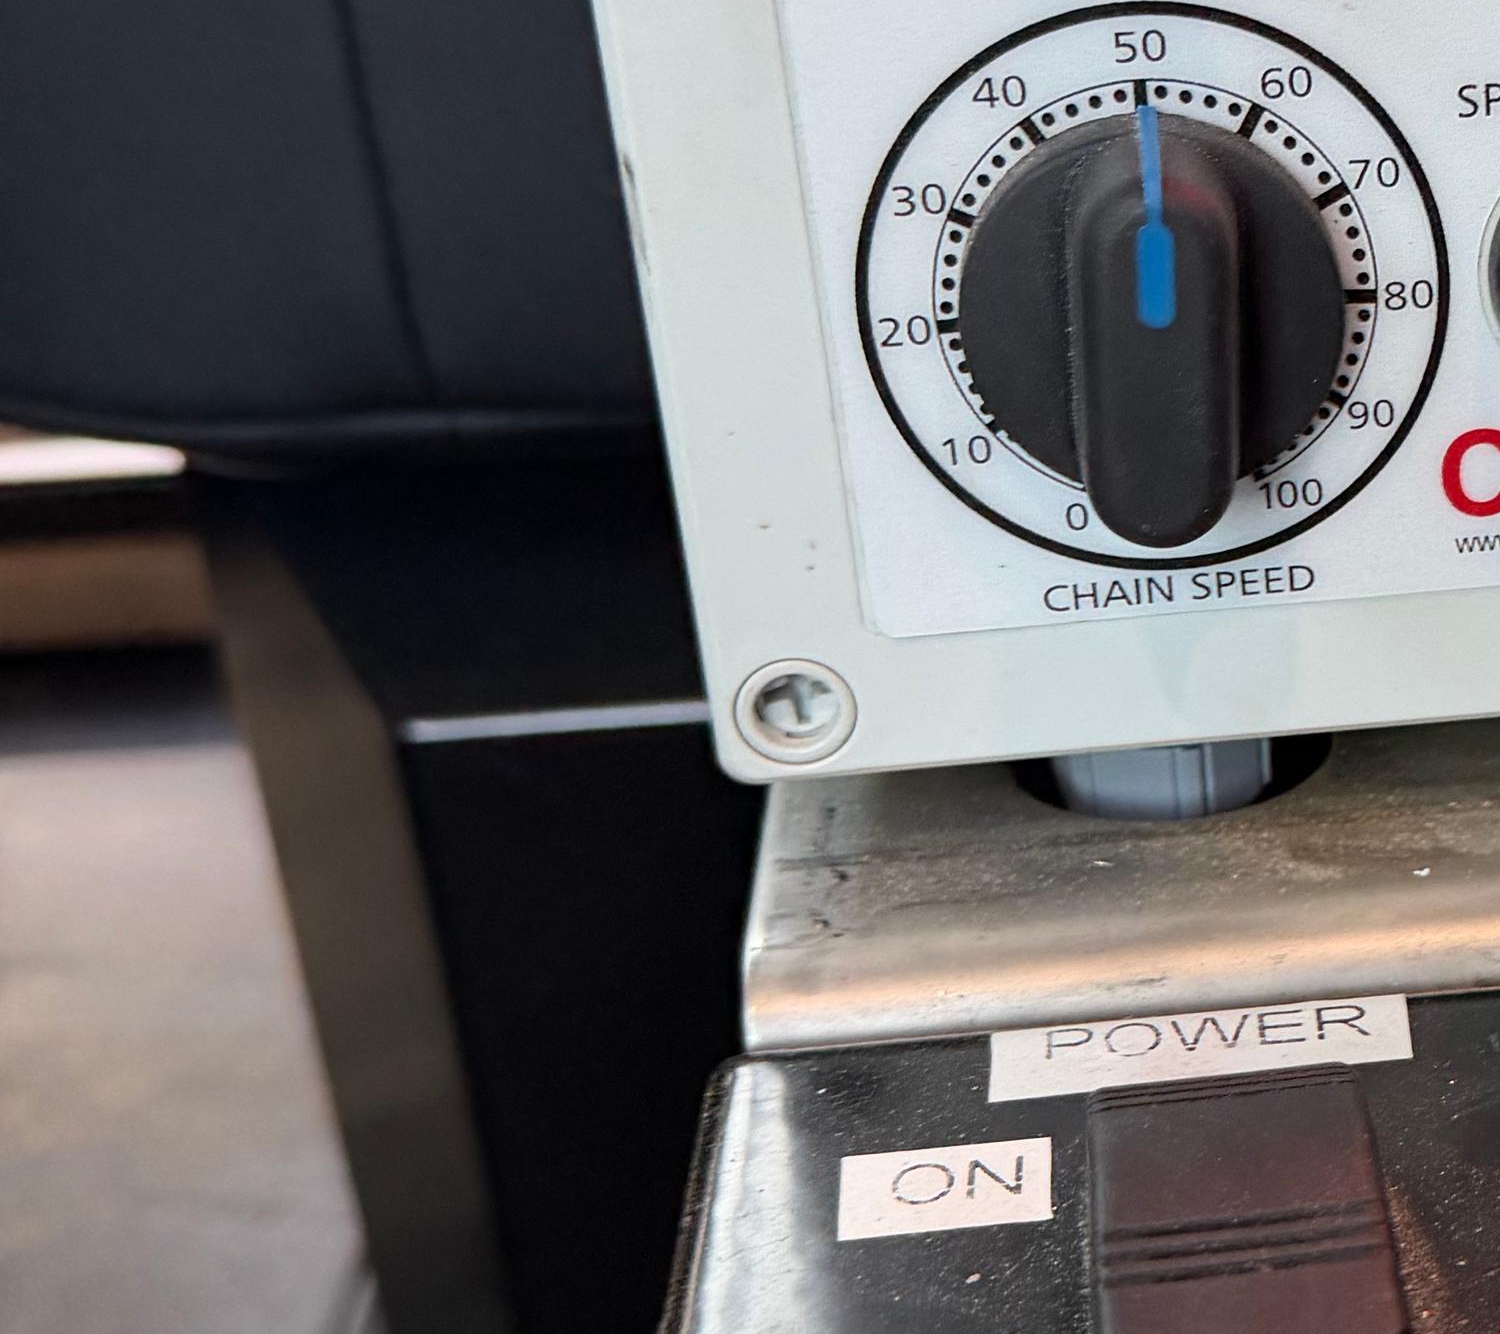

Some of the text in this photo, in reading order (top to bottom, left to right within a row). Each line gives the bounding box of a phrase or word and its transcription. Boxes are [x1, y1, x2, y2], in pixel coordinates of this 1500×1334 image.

[1113, 30, 1167, 64] 50
[972, 75, 1028, 109] 40
[1260, 67, 1313, 99] 60
[1351, 156, 1400, 190] 70
[892, 184, 947, 218] 30
[1384, 279, 1434, 311] 80
[880, 317, 932, 348] 20
[1349, 400, 1395, 430] 90
[942, 435, 993, 467] 10
[1262, 477, 1324, 511] 100
[1066, 503, 1090, 532] 0
[1043, 564, 1316, 613] CHAIN SPEED
[1045, 1004, 1372, 1060] POWER
[891, 1155, 1024, 1205] ON
